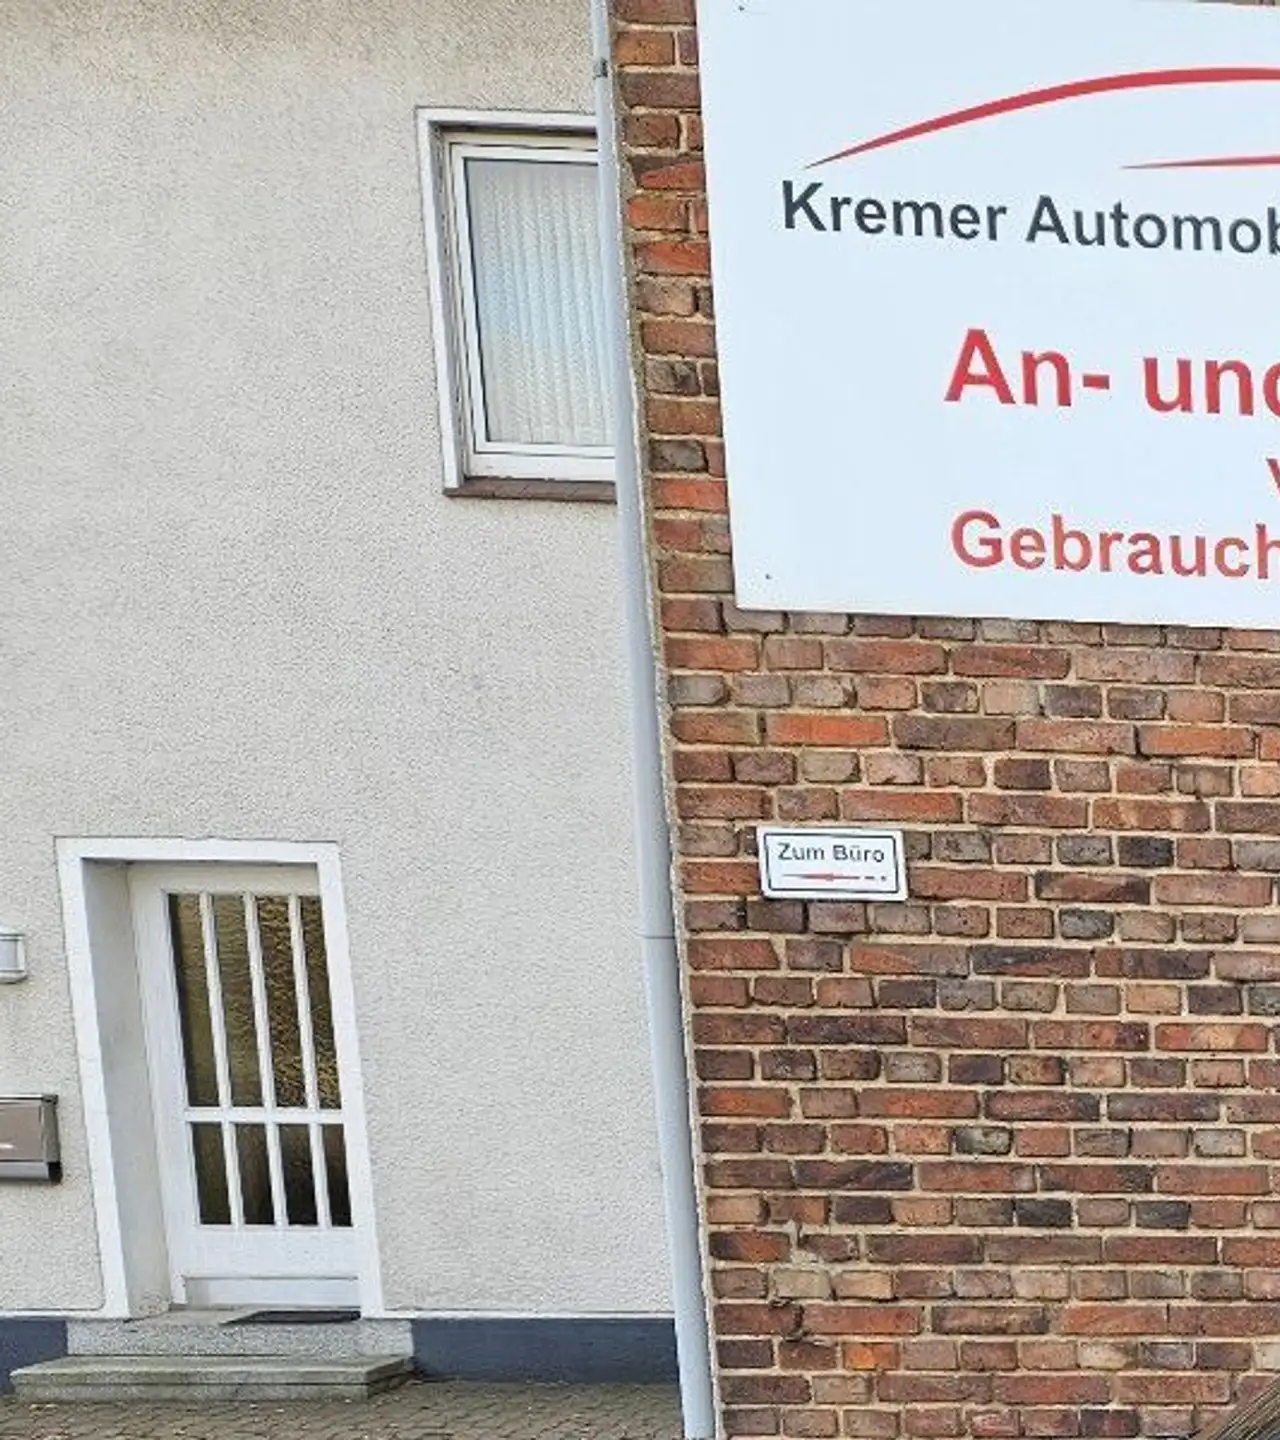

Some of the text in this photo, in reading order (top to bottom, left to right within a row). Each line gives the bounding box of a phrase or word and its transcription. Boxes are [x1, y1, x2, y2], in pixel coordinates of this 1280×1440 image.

[783, 180, 1007, 240] Kremer
[944, 328, 1110, 406] An-
[778, 843, 885, 863] Zum Büro
